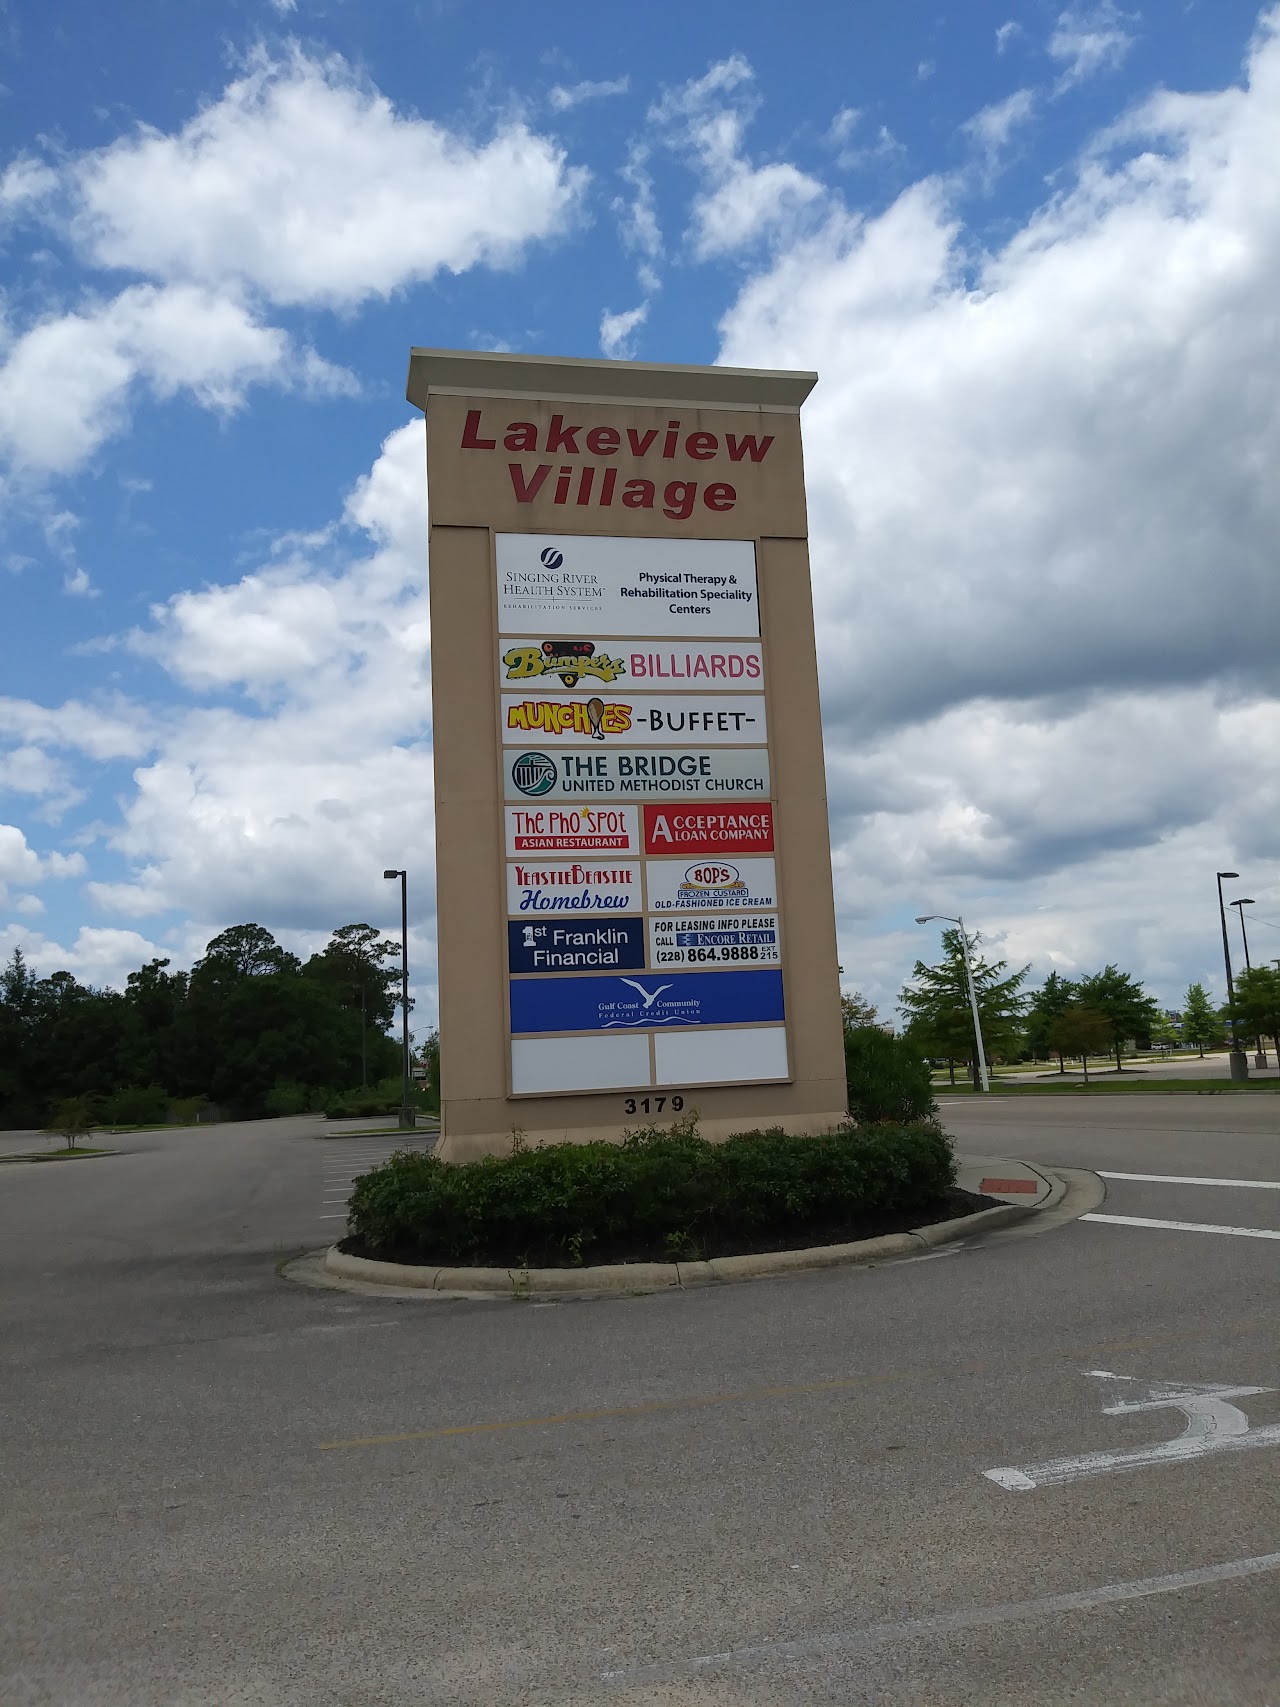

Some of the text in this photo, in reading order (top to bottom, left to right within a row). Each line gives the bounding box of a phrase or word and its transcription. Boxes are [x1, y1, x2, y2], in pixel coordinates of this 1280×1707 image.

[461, 409, 775, 463] Lakeview
[508, 463, 737, 520] Village
[506, 571, 598, 585] SINGING RIVER
[639, 572, 738, 587] Physical Therapy &
[503, 584, 553, 596] HEALTH
[620, 587, 752, 602] Rehabilitation Speciality
[503, 603, 566, 611] REHABILITATION
[669, 604, 711, 614] Centers
[630, 653, 761, 679] BILLIARDS
[561, 755, 711, 777] THE BRIDGE
[562, 778, 764, 792] UNITED METHODIST CHURCH
[651, 814, 770, 843] ACCEPTANCE
[675, 828, 770, 841] LOAN COMPANY
[521, 837, 623, 848] ASIAN RESTAURANT
[519, 888, 630, 911] Homebrew
[680, 888, 747, 898] FROZEN CUSTARD
[655, 897, 773, 909] OLD-FASHIONED ICE CREAM
[655, 918, 775, 933] FOR LEASING INFO PLEASE
[553, 928, 629, 946] Franklin
[655, 931, 773, 947] CALL ENCORE RETAIL
[533, 947, 619, 967] Financial
[656, 946, 759, 964] (228) 864.9888
[760, 951, 778, 960] 215
[598, 1002, 616, 1011] Gulf
[656, 999, 701, 1009] Community
[598, 1011, 634, 1019] Federal
[639, 1009, 669, 1017] Credit
[624, 1095, 684, 1115] 3179
